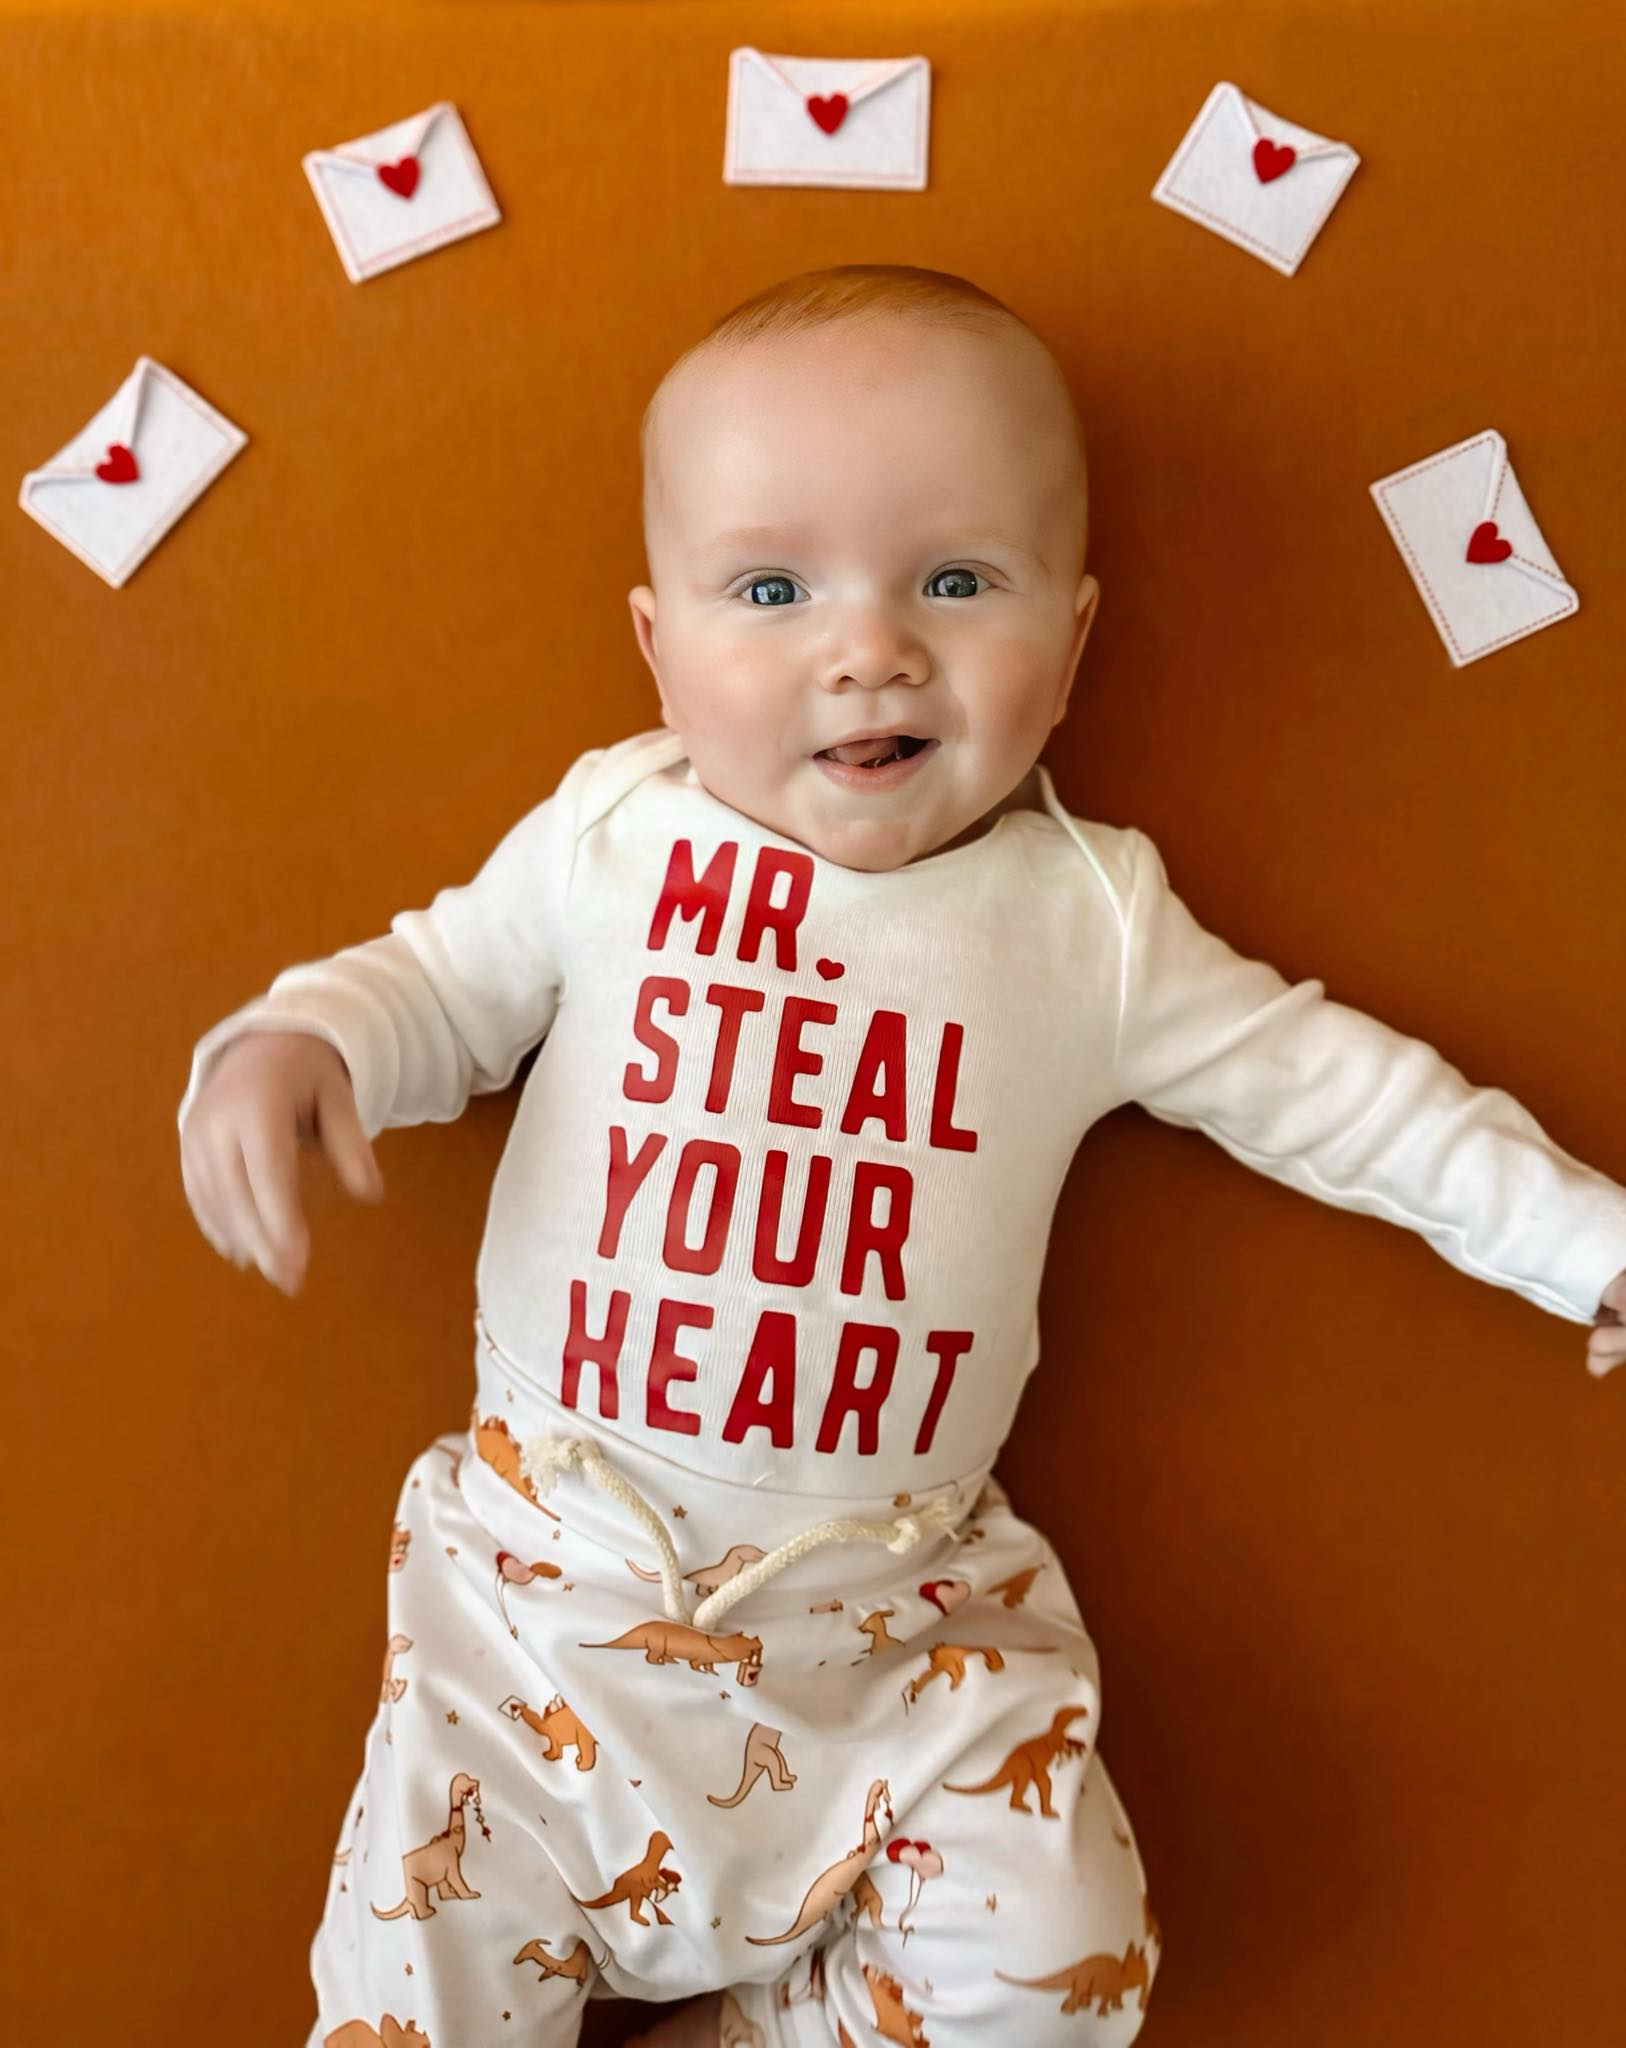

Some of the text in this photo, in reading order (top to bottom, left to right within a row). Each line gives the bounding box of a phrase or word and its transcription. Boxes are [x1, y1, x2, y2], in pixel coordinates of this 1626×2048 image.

[623, 976, 977, 1153] STEAL
[597, 1126, 913, 1301] YOUR
[561, 1279, 974, 1455] HEART
